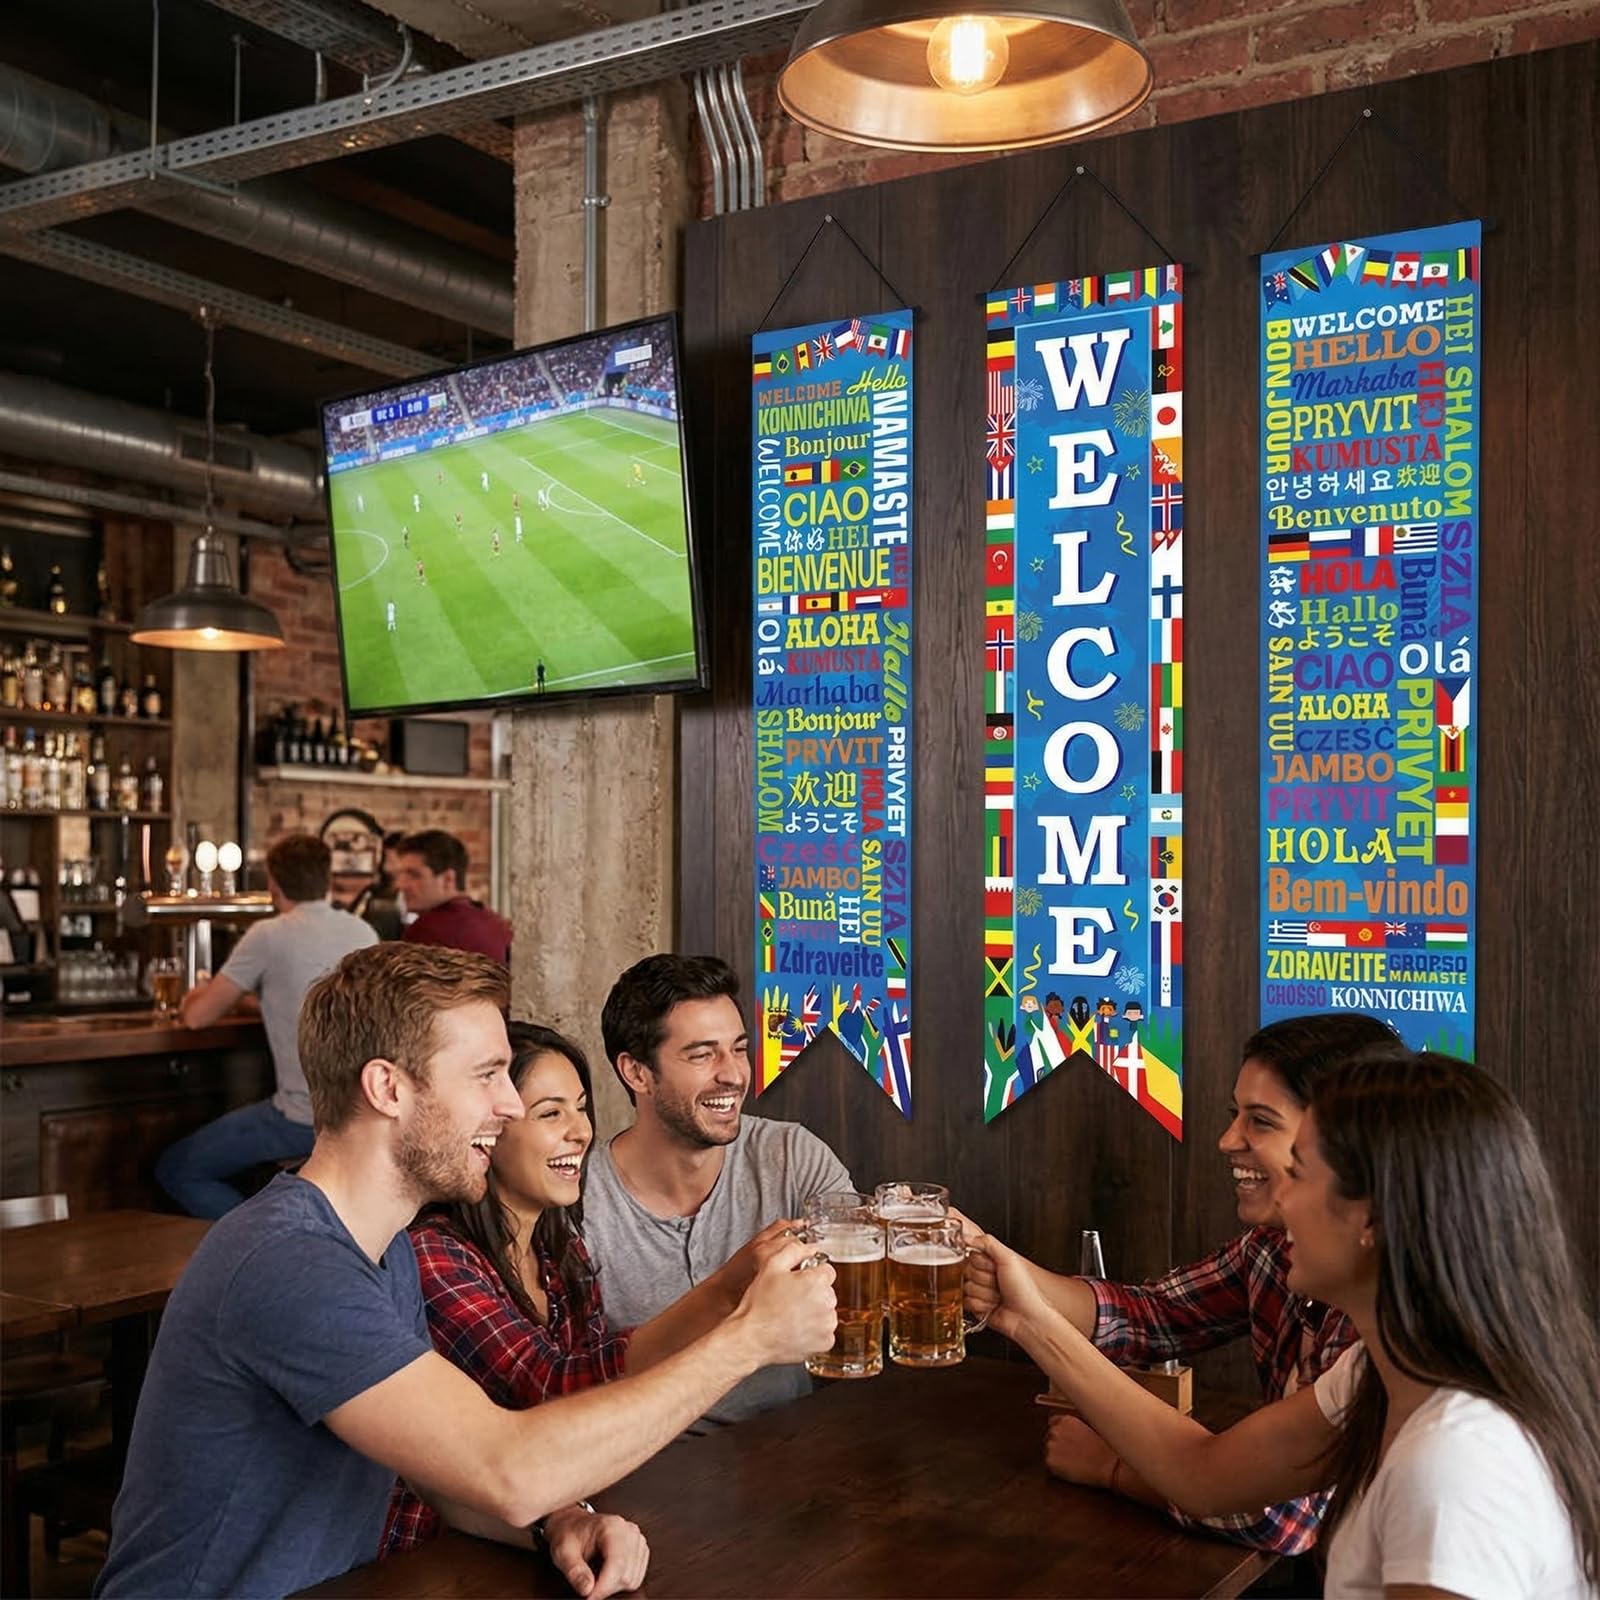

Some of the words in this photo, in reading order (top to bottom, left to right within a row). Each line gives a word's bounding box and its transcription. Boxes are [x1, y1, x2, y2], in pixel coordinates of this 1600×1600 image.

[1292, 299, 1444, 338] WELCOME
[1445, 293, 1473, 355] HEI
[1293, 324, 1441, 371] HELLO
[759, 380, 842, 405] WELCOME
[847, 364, 908, 394] Hello
[1266, 319, 1291, 474] BONJOUR
[758, 396, 870, 436] KONNICHIWA
[1293, 393, 1417, 441] PRYVIT
[784, 431, 870, 459] Bonjour
[1292, 432, 1443, 473] KUMUSTA
[1443, 366, 1473, 516] SHALOM
[873, 390, 908, 546] NAMASTE
[1397, 463, 1441, 488] 欢迎
[758, 438, 781, 556] WELCOME
[784, 486, 869, 527] CIAO
[1268, 497, 1442, 530] Benvenuto
[785, 527, 825, 552] 你好
[828, 525, 869, 549] HEI
[758, 548, 890, 594] BIENVENUE
[1301, 560, 1397, 594] HOLA
[1441, 521, 1472, 637] SZIA
[1300, 596, 1399, 625] Hallo
[758, 619, 784, 676] Olá
[785, 613, 880, 649] ALOHA
[1298, 624, 1395, 650] ようこそ
[787, 649, 880, 674] KUMUSTA
[883, 612, 909, 723] Hallo
[1034, 328, 1130, 976] WELCOME
[1269, 636, 1294, 704] SAIN
[1294, 652, 1394, 691] CIAO
[1400, 635, 1471, 675] Olá
[757, 674, 881, 706] Marhaba
[1298, 693, 1390, 721] ALOHA
[786, 706, 881, 737] Bonjour
[786, 737, 883, 764] PRYVIT
[1268, 753, 1394, 783] JAMBO
[757, 709, 784, 833] SHALOM
[786, 769, 857, 809] 欢迎
[887, 726, 906, 837] PRIVYET
[1397, 678, 1433, 865] PRIVYET
[861, 768, 884, 835] HOLA
[1268, 786, 1394, 822] PRYVIT
[785, 812, 858, 833] ようこそ
[759, 834, 858, 864] Cześć
[1267, 828, 1396, 864] HOLA
[778, 866, 860, 890] JAMBO
[861, 839, 881, 903] SAIN
[883, 840, 906, 934] SZIA
[778, 891, 837, 921] Bună
[1268, 867, 1468, 916] Bem-vindo
[839, 896, 860, 944] HEI
[779, 941, 884, 978] Zdraveite
[1331, 987, 1467, 1013] KONNICHIWA
